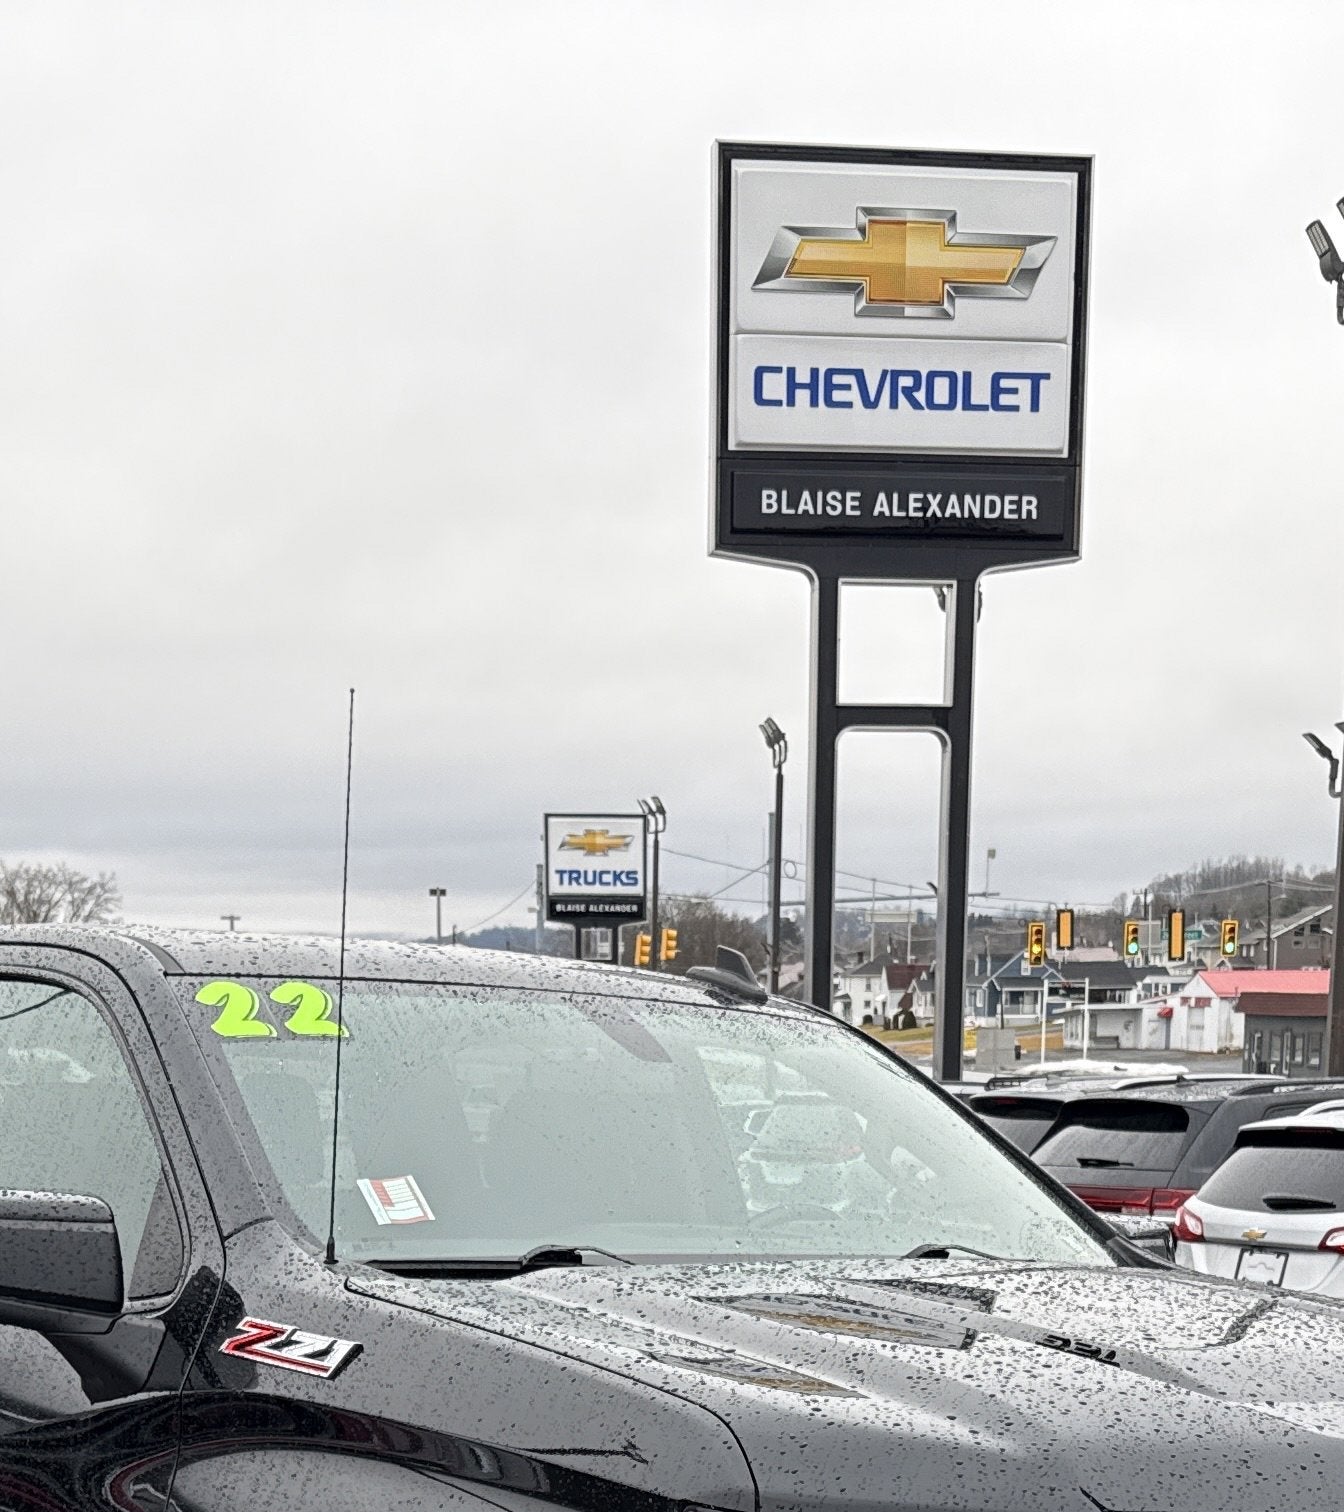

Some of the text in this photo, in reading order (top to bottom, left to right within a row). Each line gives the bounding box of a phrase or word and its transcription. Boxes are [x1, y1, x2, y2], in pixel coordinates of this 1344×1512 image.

[754, 366, 1050, 412] CHEVROLET
[761, 489, 1038, 520] BLAISE ALEXANDER
[555, 870, 638, 886] TRUCKS
[556, 904, 638, 913] BLAISE ALEXANDER
[195, 981, 349, 1038] 22
[218, 1316, 364, 1380] Z71
